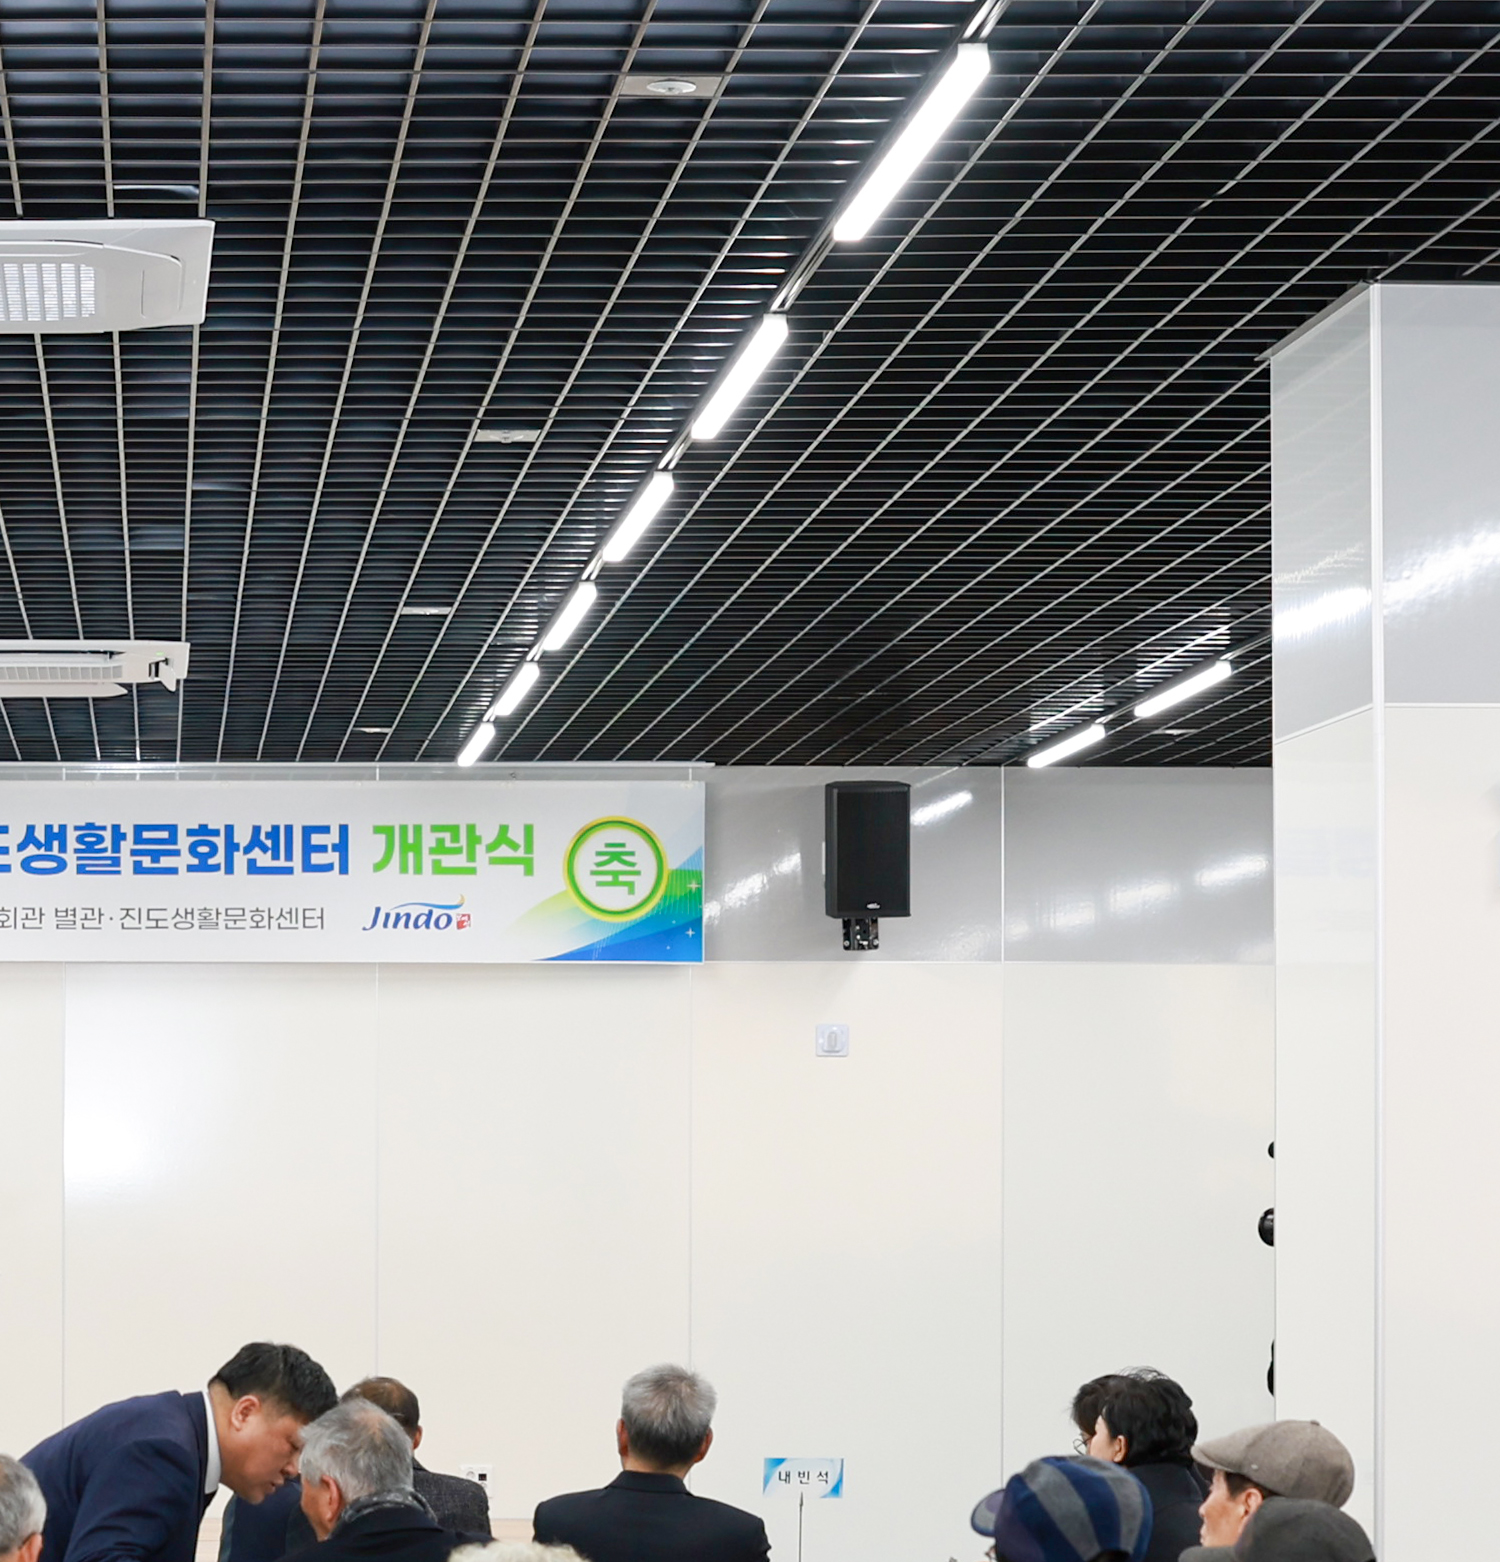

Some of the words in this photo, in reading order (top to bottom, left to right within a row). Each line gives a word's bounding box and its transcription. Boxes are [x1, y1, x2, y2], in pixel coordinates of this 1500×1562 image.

[372, 823, 535, 877] 개관식
[589, 842, 642, 896] 축
[362, 906, 453, 931] Jindo
